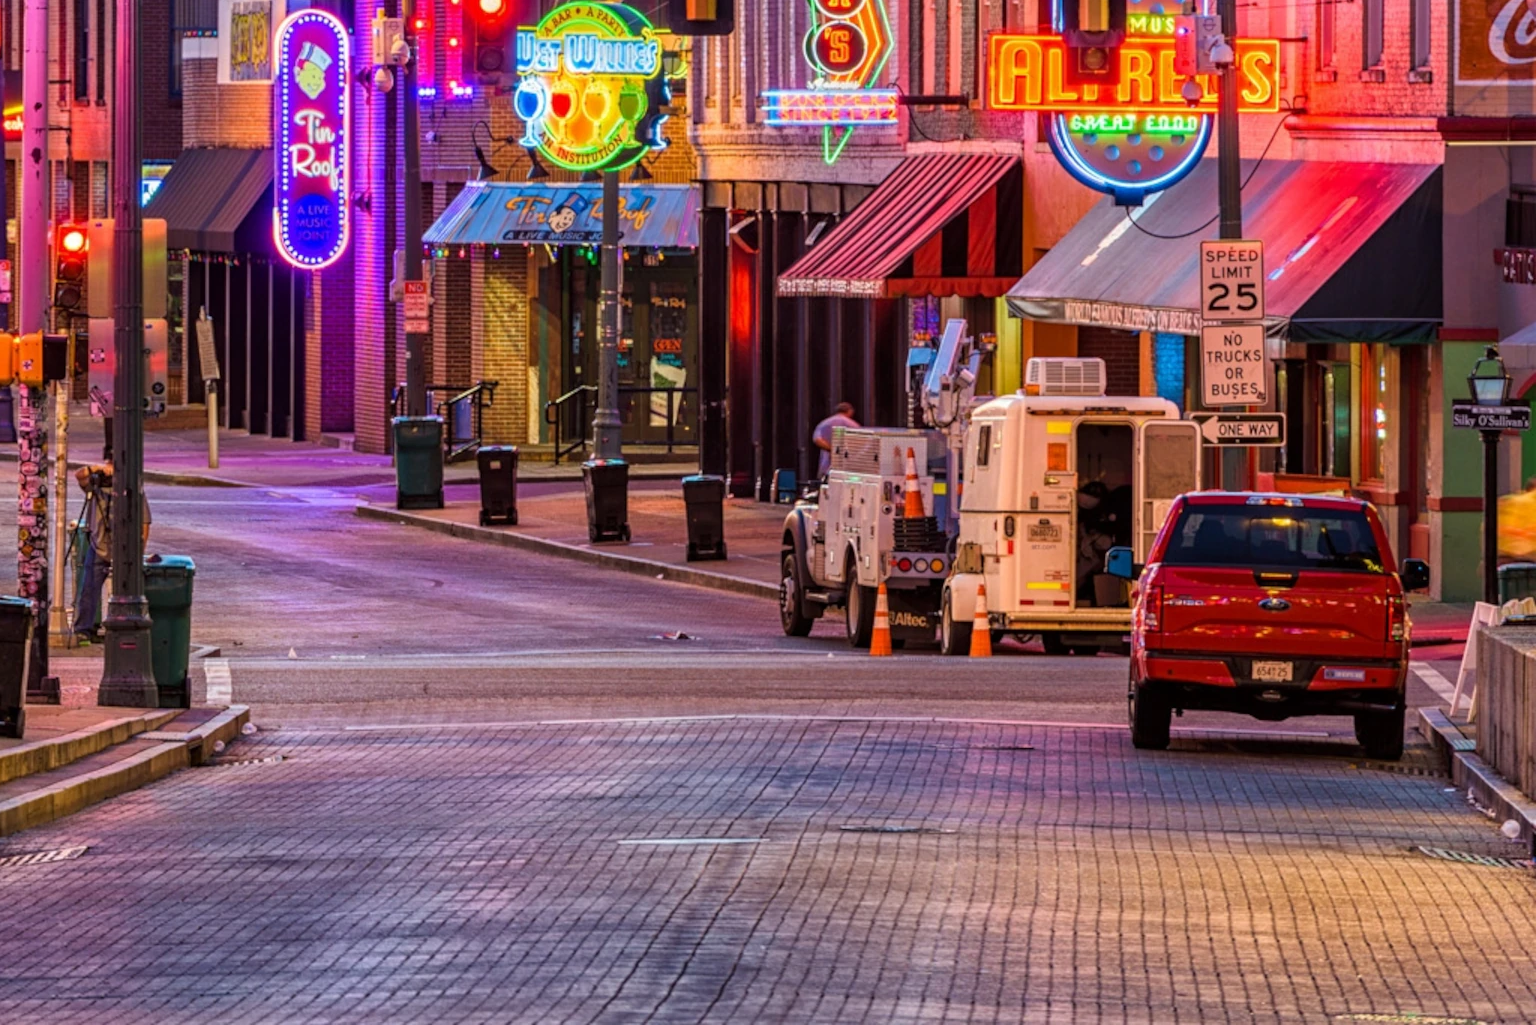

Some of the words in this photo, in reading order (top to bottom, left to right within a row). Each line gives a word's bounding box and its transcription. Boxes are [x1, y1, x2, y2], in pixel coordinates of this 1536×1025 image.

[544, 25, 552, 37] A
[551, 10, 571, 27] BAR
[587, 6, 595, 17] A
[596, 9, 627, 37] PARTY
[780, 94, 898, 107] BURGERS
[780, 108, 841, 121] SINCE
[849, 108, 898, 121] 1912
[293, 108, 335, 146] Tin
[1070, 112, 1136, 132] GREAT
[556, 134, 624, 165] INSTITUTION
[288, 143, 341, 192] Roof
[297, 205, 306, 215] A
[307, 205, 330, 215] LIVE
[505, 194, 553, 226] Tin
[296, 218, 332, 228] MUSIC
[297, 230, 331, 240] JOINT
[504, 231, 514, 241] A
[517, 231, 544, 241] LIVE
[548, 230, 584, 241] MUSIC
[1205, 249, 1259, 263] SPEED
[1211, 265, 1253, 279] LIMIT
[1207, 282, 1259, 312] 25
[1223, 334, 1243, 347] NO
[1206, 349, 1262, 364] TRUCKS
[1225, 367, 1244, 380] OR
[1211, 382, 1258, 397] BUSES
[1453, 414, 1477, 429] Silky
[1477, 414, 1530, 428] O'Sullivan's
[1218, 423, 1243, 436] ONE
[1248, 424, 1275, 436] WAY
